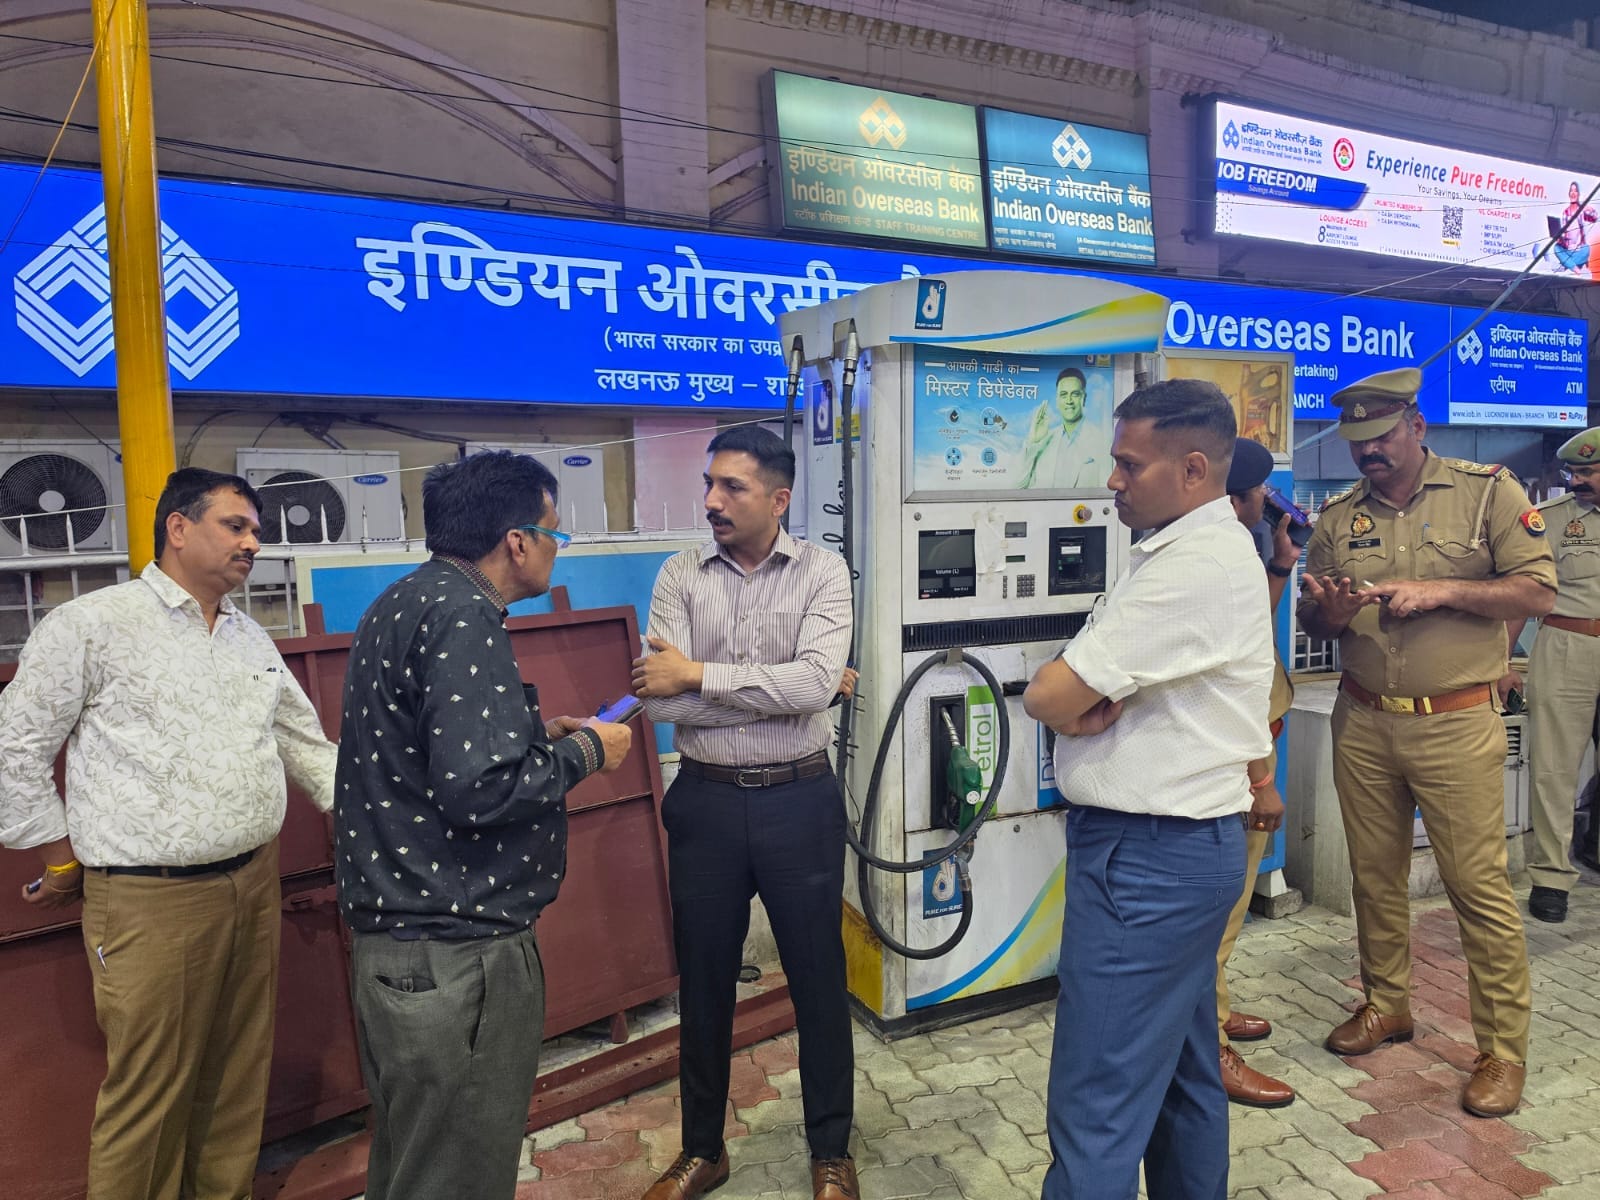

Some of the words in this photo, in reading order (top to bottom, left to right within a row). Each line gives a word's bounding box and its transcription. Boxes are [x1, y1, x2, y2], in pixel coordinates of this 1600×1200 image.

[1241, 135, 1264, 147] Indian
[1267, 140, 1301, 154] Overseas
[1304, 146, 1322, 158] Bank
[1218, 162, 1245, 181] IOB
[1248, 167, 1317, 193] FREEDOM
[1366, 150, 1447, 183] Experience
[1451, 166, 1482, 189] Pure
[1487, 172, 1548, 200] Freedom.
[791, 177, 848, 206] Indian
[852, 185, 934, 218] Overseas
[938, 198, 980, 223] Bank
[1418, 184, 1432, 195] Your
[1463, 191, 1477, 202] Your
[993, 197, 1042, 222] Indian
[1045, 203, 1115, 231] Overseas
[1117, 212, 1154, 236] Bank
[1319, 214, 1344, 225] LOUNGE
[875, 219, 901, 231] STAFF
[905, 222, 945, 237] TRAINING
[946, 228, 980, 240] CENTRE
[1318, 225, 1326, 243] 8
[355, 221, 622, 313] इण्डियन
[637, 245, 878, 326] ओवरसी
[1166, 301, 1331, 352] Overseas
[1342, 315, 1415, 359] Bank
[661, 334, 717, 353] सरकार
[722, 337, 744, 355] का
[1490, 345, 1517, 359] Indian
[1520, 347, 1559, 362] Overseas
[1562, 350, 1583, 363] Bank
[946, 357, 978, 373] आपकी
[1007, 363, 1020, 375] का
[1294, 364, 1338, 382] ertaking)
[594, 368, 680, 392] लखनऊ
[686, 372, 734, 402] मुख्य
[925, 374, 971, 398] मिस्टर
[977, 376, 1039, 401] डिपेंडेबल
[1489, 374, 1517, 394] एटीएम
[1565, 382, 1583, 394] ATM
[1292, 393, 1324, 409] ANCH
[973, 714, 991, 773] etrol
